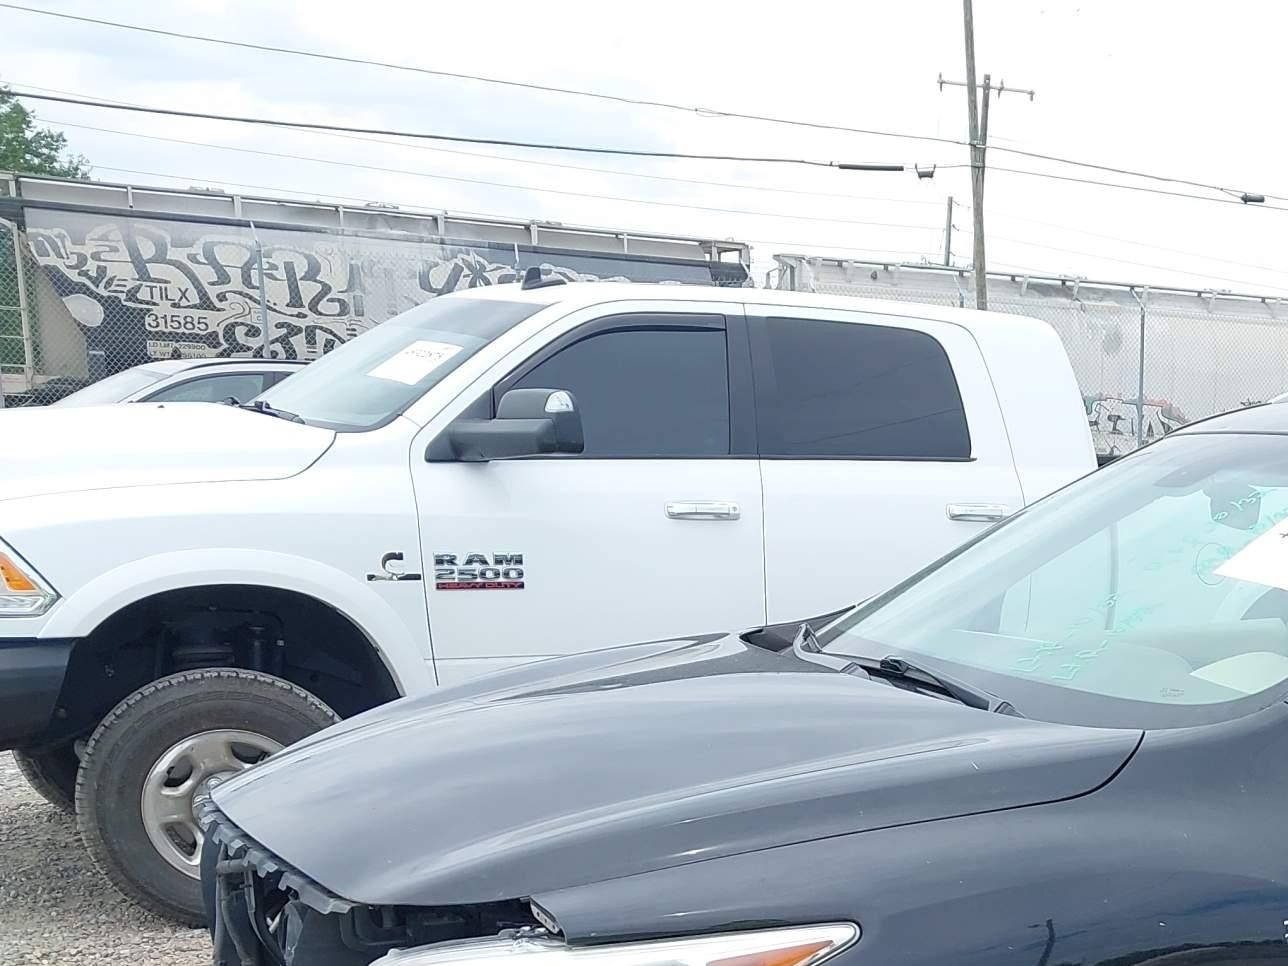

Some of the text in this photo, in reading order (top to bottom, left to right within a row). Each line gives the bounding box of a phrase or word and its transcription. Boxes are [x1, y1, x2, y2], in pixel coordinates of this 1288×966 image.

[144, 285, 190, 303] TILX
[147, 313, 209, 332] 31585
[434, 553, 523, 566] RAM
[435, 567, 524, 581] 2500
